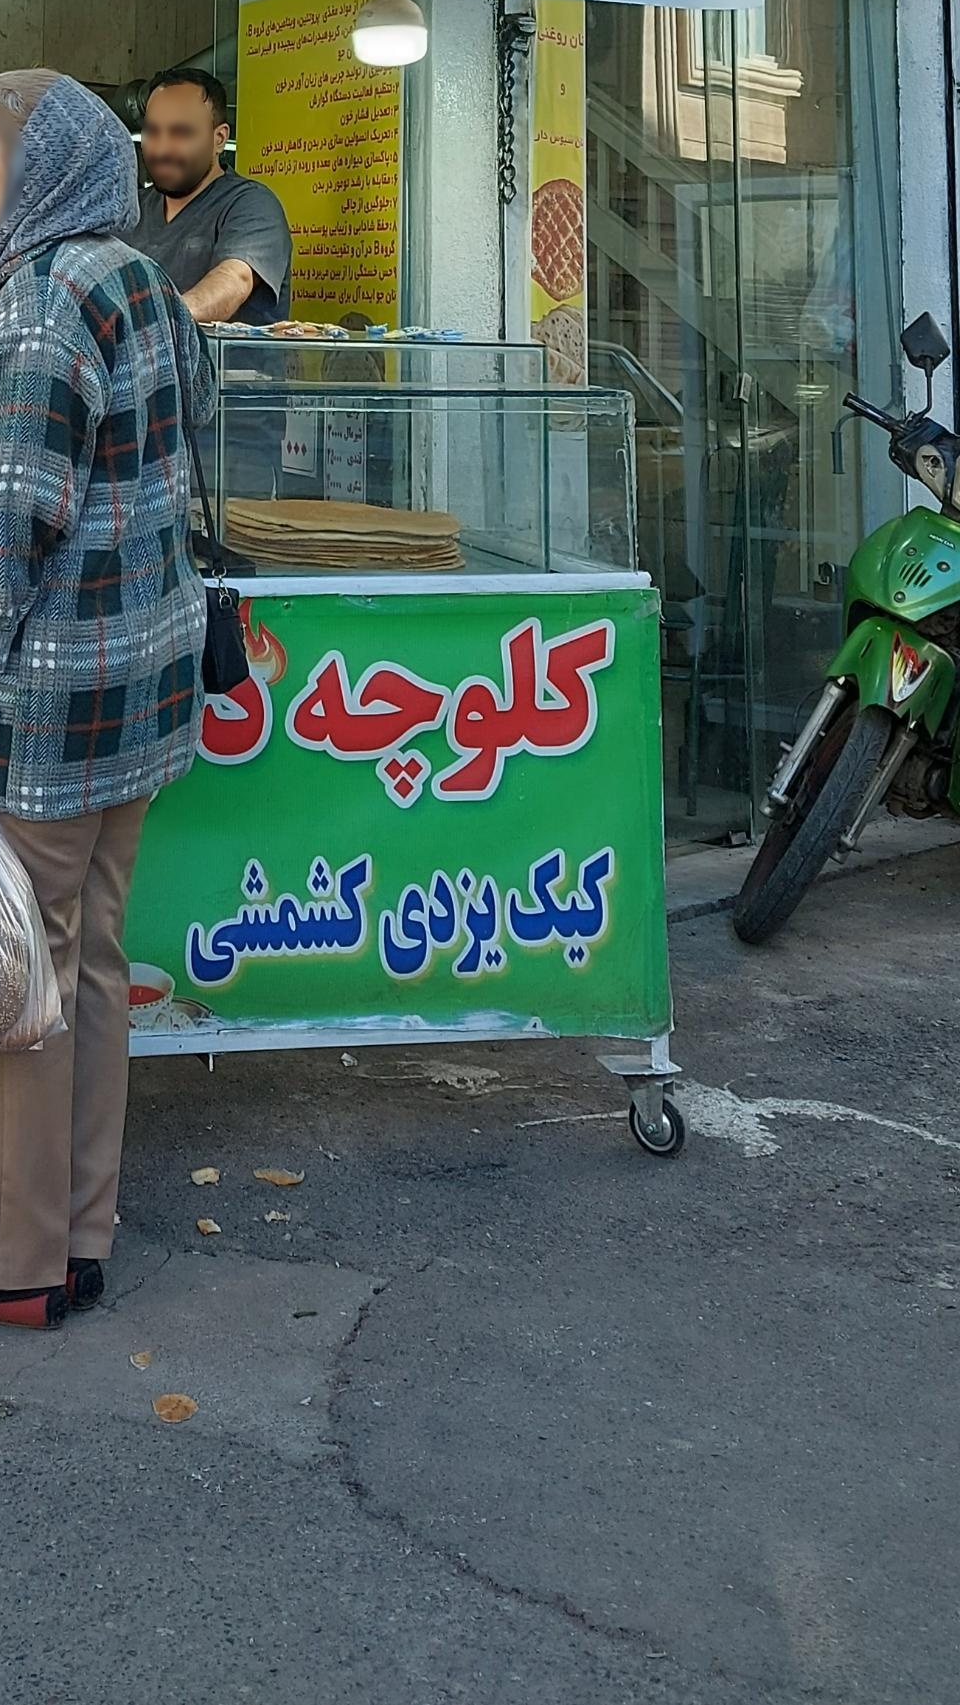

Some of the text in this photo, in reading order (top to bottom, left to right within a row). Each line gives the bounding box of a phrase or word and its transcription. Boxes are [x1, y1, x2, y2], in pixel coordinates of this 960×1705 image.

[322, 5, 339, 23] مغذی
[339, 3, 352, 16] مواد
[537, 26, 568, 47] روغنی
[560, 82, 567, 96] و
[340, 111, 353, 125] خون
[533, 129, 548, 142] دار
[373, 239, 380, 256] B
[290, 622, 610, 802] کلوچه
[189, 850, 612, 984] کیک یزدی کشمشی
